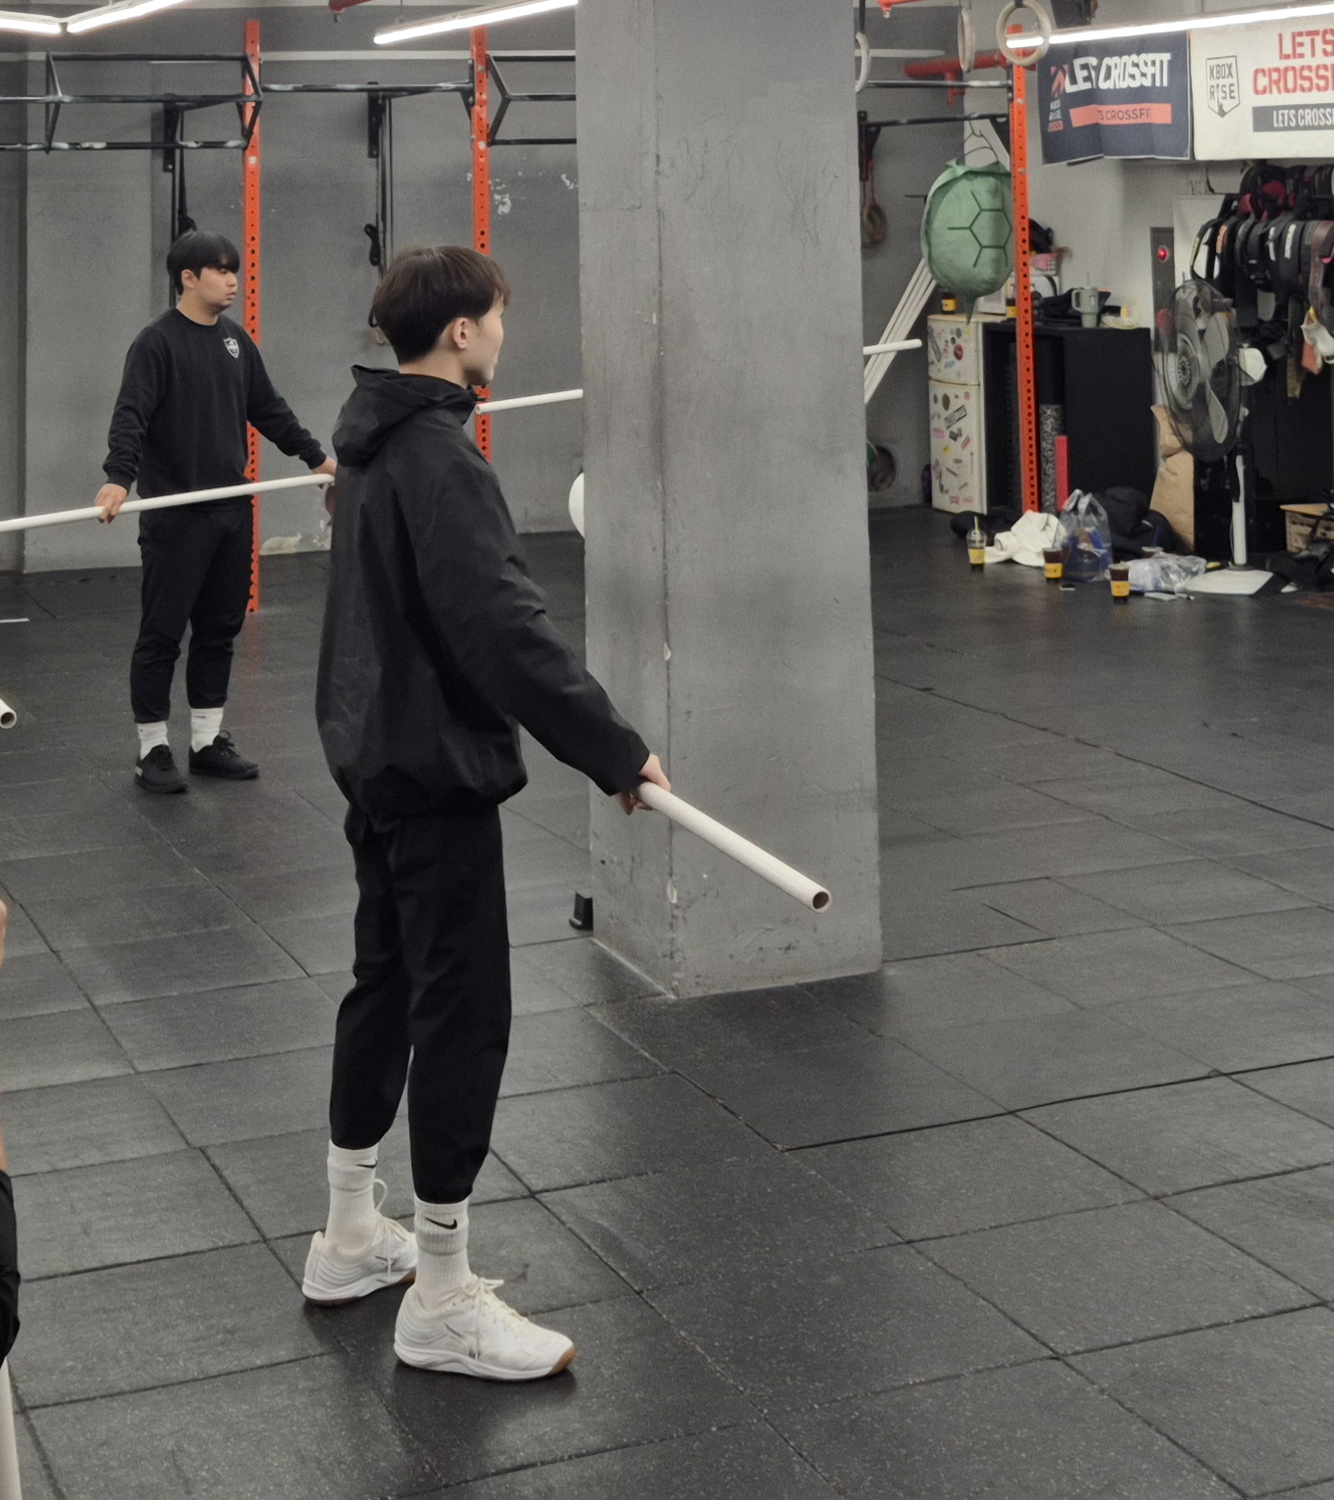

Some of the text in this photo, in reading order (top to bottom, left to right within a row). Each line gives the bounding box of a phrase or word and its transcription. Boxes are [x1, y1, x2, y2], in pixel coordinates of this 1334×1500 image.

[1098, 52, 1172, 90] CROSSFIT
[1209, 62, 1234, 81] KBOX
[1273, 109, 1296, 128] LETS
